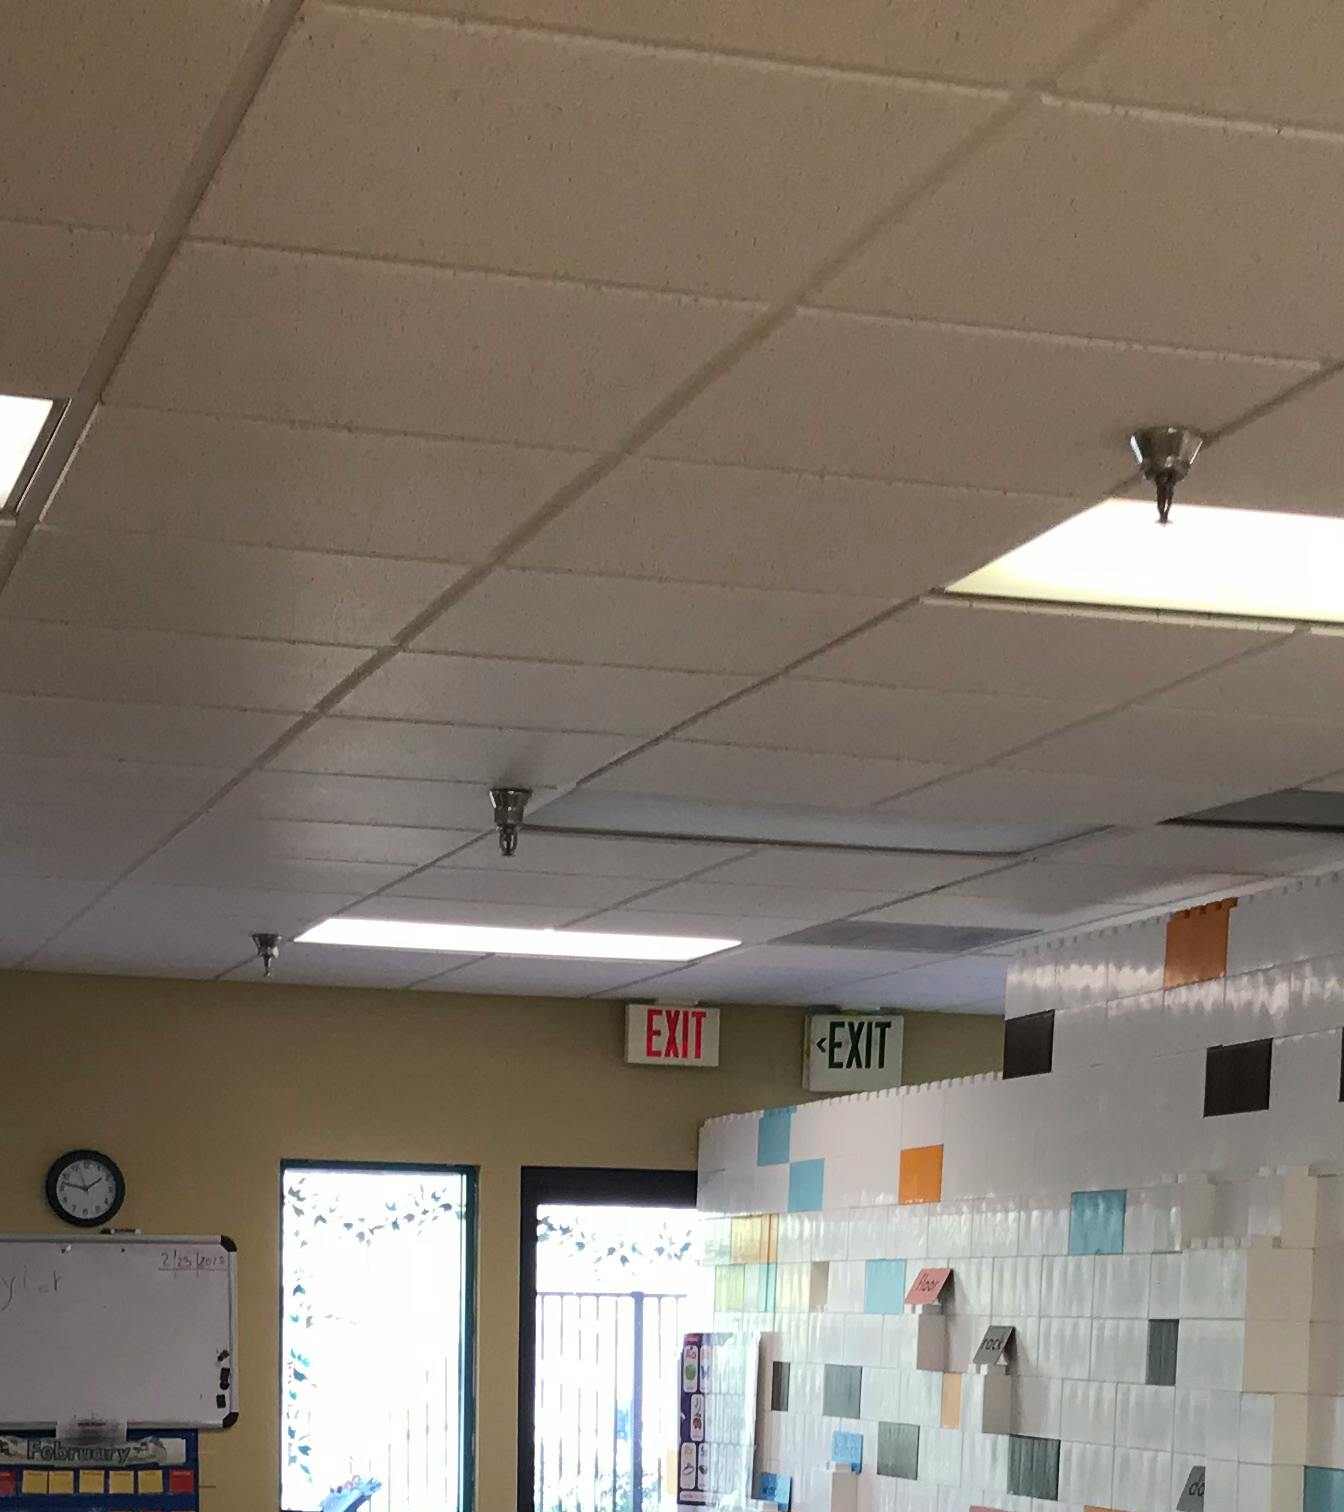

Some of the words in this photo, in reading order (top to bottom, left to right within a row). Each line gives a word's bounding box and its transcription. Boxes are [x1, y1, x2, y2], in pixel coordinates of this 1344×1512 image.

[646, 1008, 706, 1059] EXIT
[828, 1020, 891, 1069] EXIT
[27, 1439, 131, 1464] February
